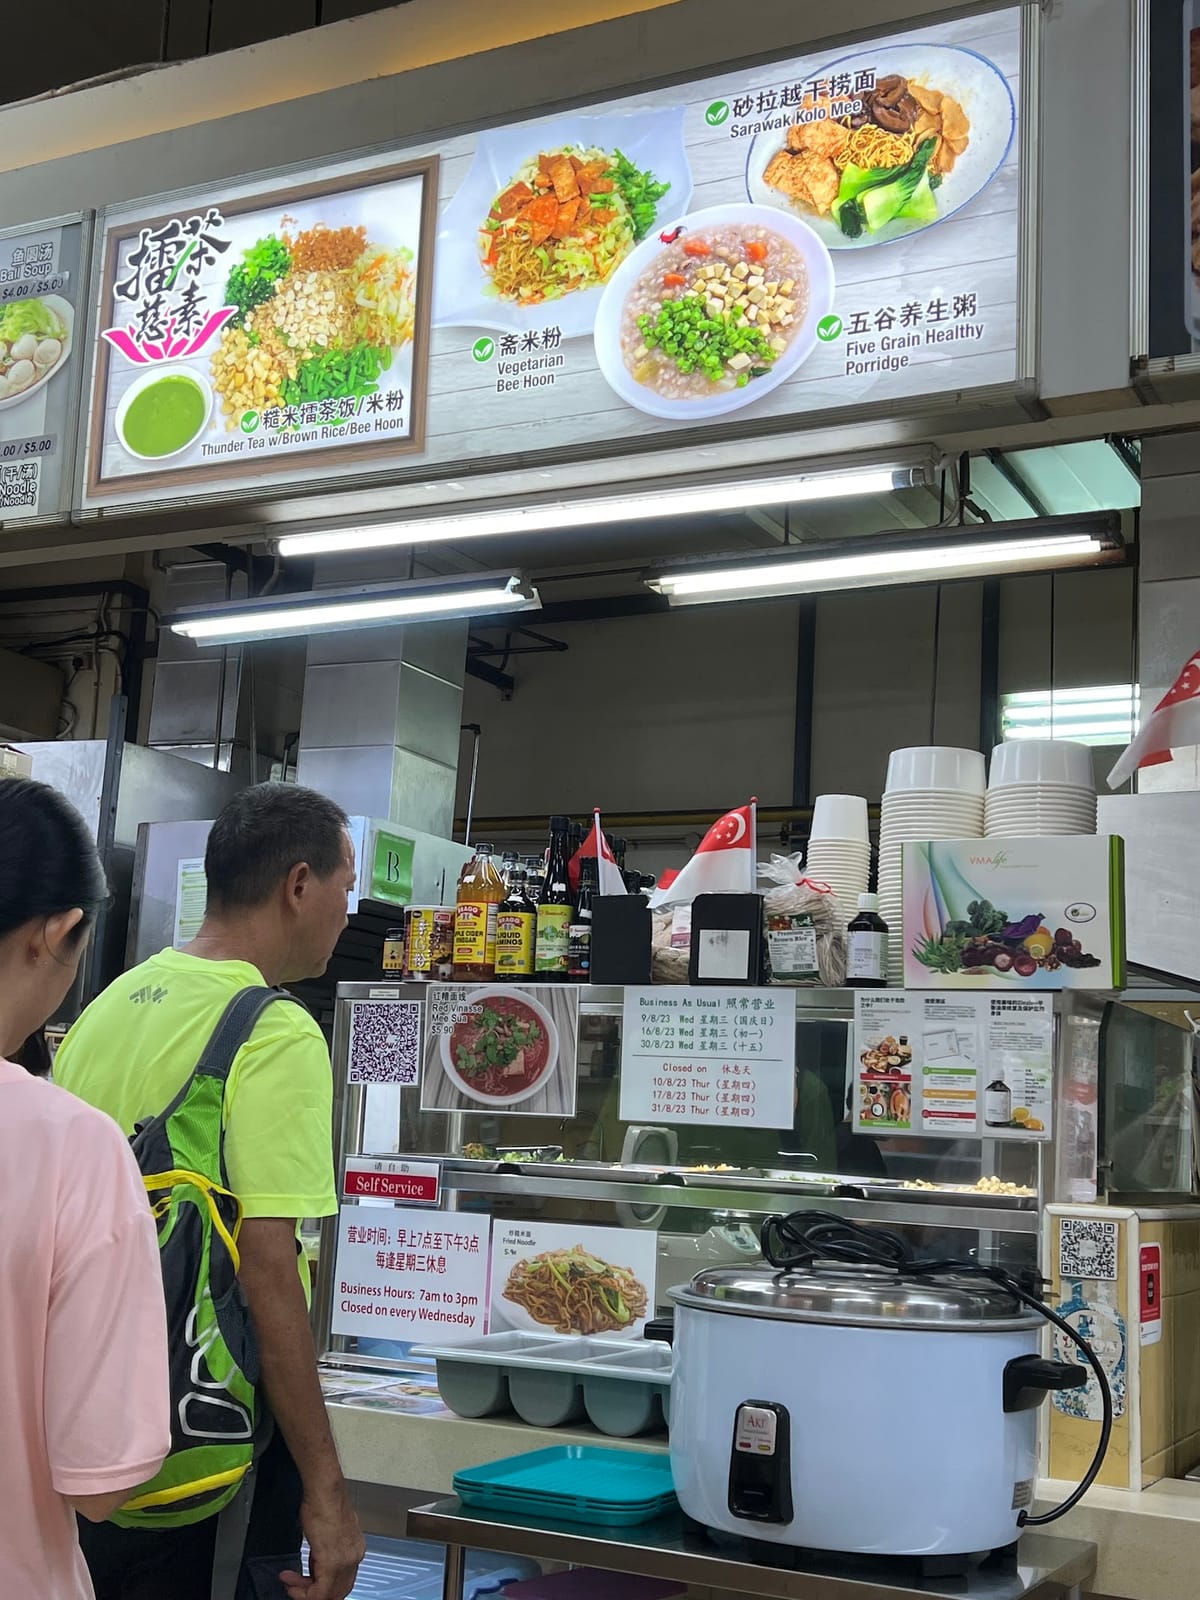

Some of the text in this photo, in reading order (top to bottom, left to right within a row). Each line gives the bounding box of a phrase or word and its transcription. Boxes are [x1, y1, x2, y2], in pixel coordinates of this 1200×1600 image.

[733, 67, 877, 117] 砂拉越干捞面
[730, 100, 861, 138] Sarawak Kolo Mee
[0, 263, 52, 282] Ball Soup
[847, 293, 977, 335] 五谷养生粥
[499, 326, 562, 356] 斋米粉
[846, 323, 984, 357] Five Grain Healthy
[498, 354, 563, 376] Vegetarian
[846, 355, 909, 376] Porridge
[496, 374, 555, 393] Bee Hoon
[262, 389, 404, 430] 糙米擂茶饭/米粉
[201, 417, 404, 457] Thunder Tea w/Brown Rice/Bee Hoon
[24, 440, 51, 454] $5.00
[0, 480, 37, 496] Noodle
[387, 851, 400, 883] B
[432, 1003, 483, 1013] Red Vinasse
[639, 997, 775, 1010] Business As Usual 照常营业
[432, 1013, 468, 1023] Mee Sua
[641, 1014, 671, 1024] 9/8/23
[679, 1015, 694, 1024] Wed
[641, 1027, 675, 1037] 16/8/23
[679, 1028, 694, 1037] Wed
[640, 1040, 674, 1049] 30/8/23
[678, 1041, 694, 1050] Wed
[663, 1063, 751, 1075] Closed on 休息天
[653, 1078, 687, 1087] 10/8/23
[691, 1079, 710, 1089] Thur
[653, 1090, 686, 1101] 17/8/23
[691, 1092, 710, 1101] Thur
[651, 1104, 686, 1113] 31/8/23
[690, 1105, 709, 1115] Thur
[356, 1176, 424, 1196] Self Service
[376, 1250, 447, 1274] 每逢星期三休息
[340, 1282, 478, 1307] Business Hours: 7am to 3pm
[341, 1300, 476, 1328] Closed on every Wednesday
